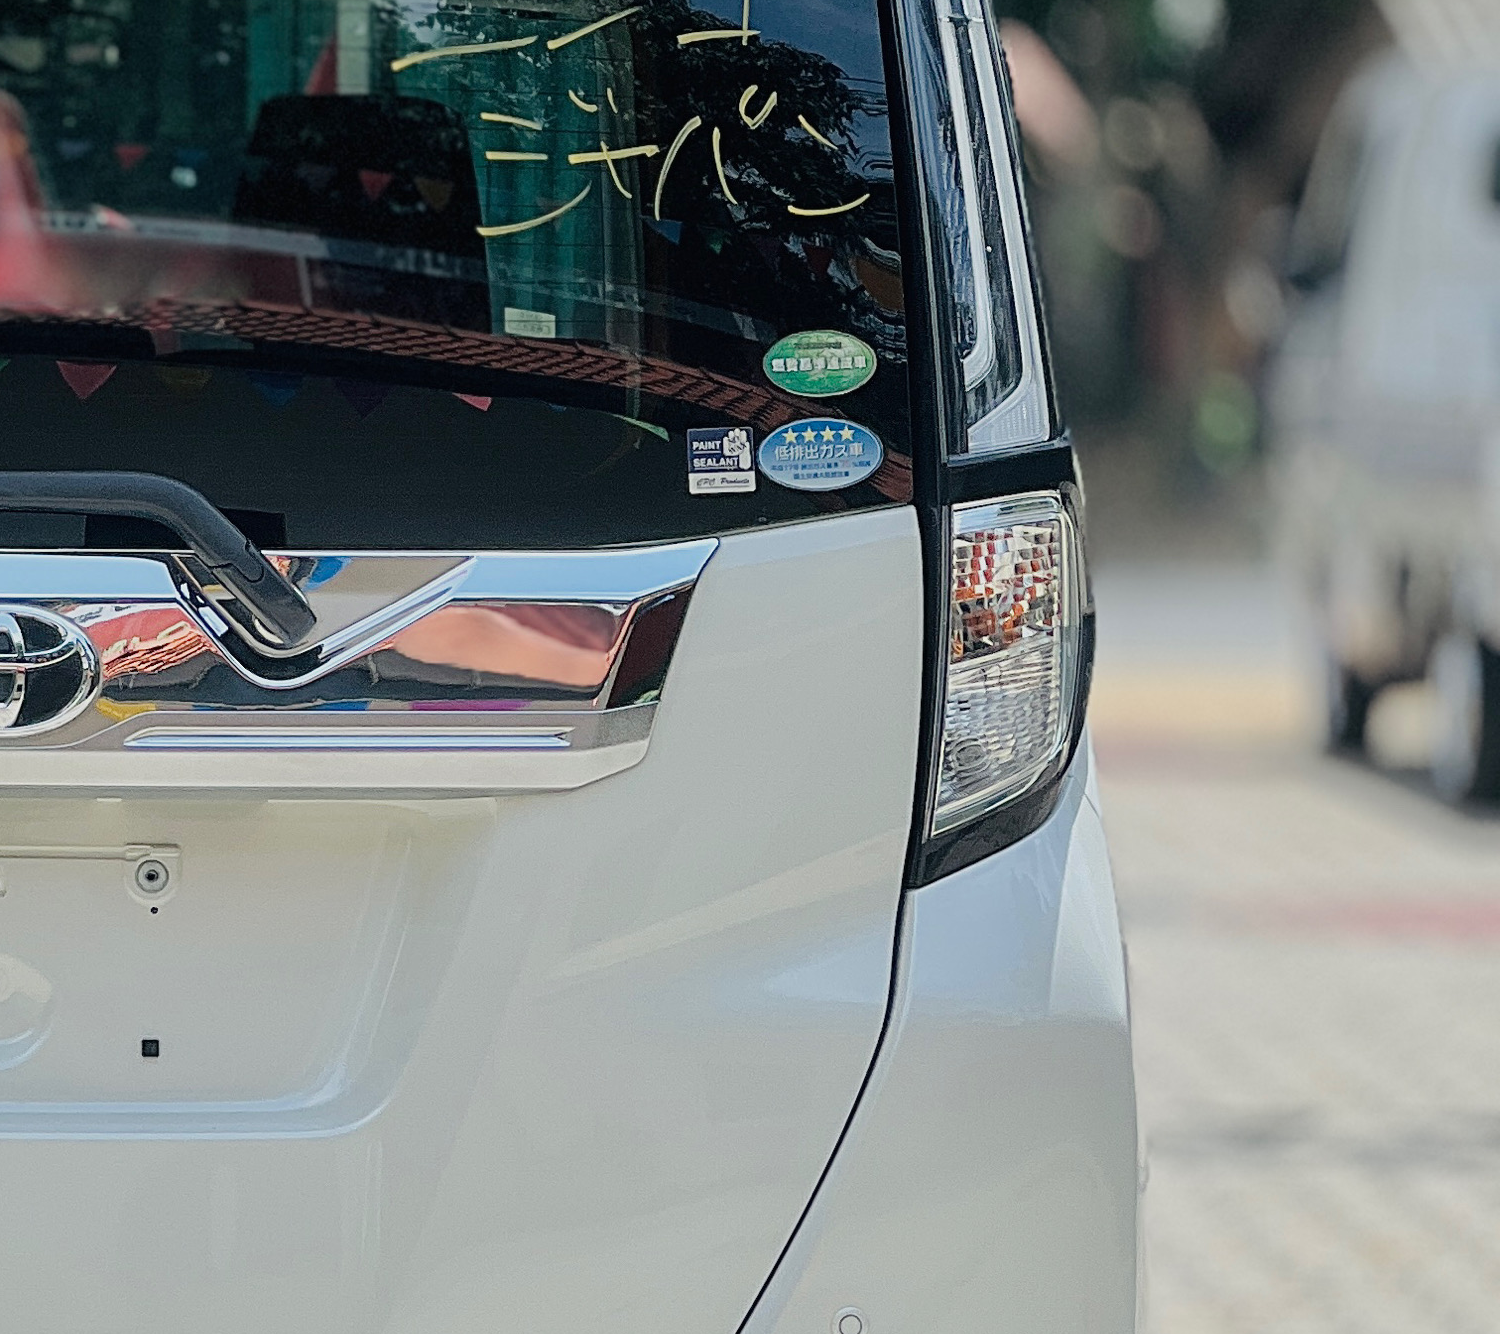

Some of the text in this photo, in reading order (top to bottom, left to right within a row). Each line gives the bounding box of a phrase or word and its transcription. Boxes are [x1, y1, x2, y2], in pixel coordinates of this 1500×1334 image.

[692, 440, 722, 451] PAINT
[774, 442, 865, 462] 低排出ガス車
[692, 456, 739, 468] SEALANT
